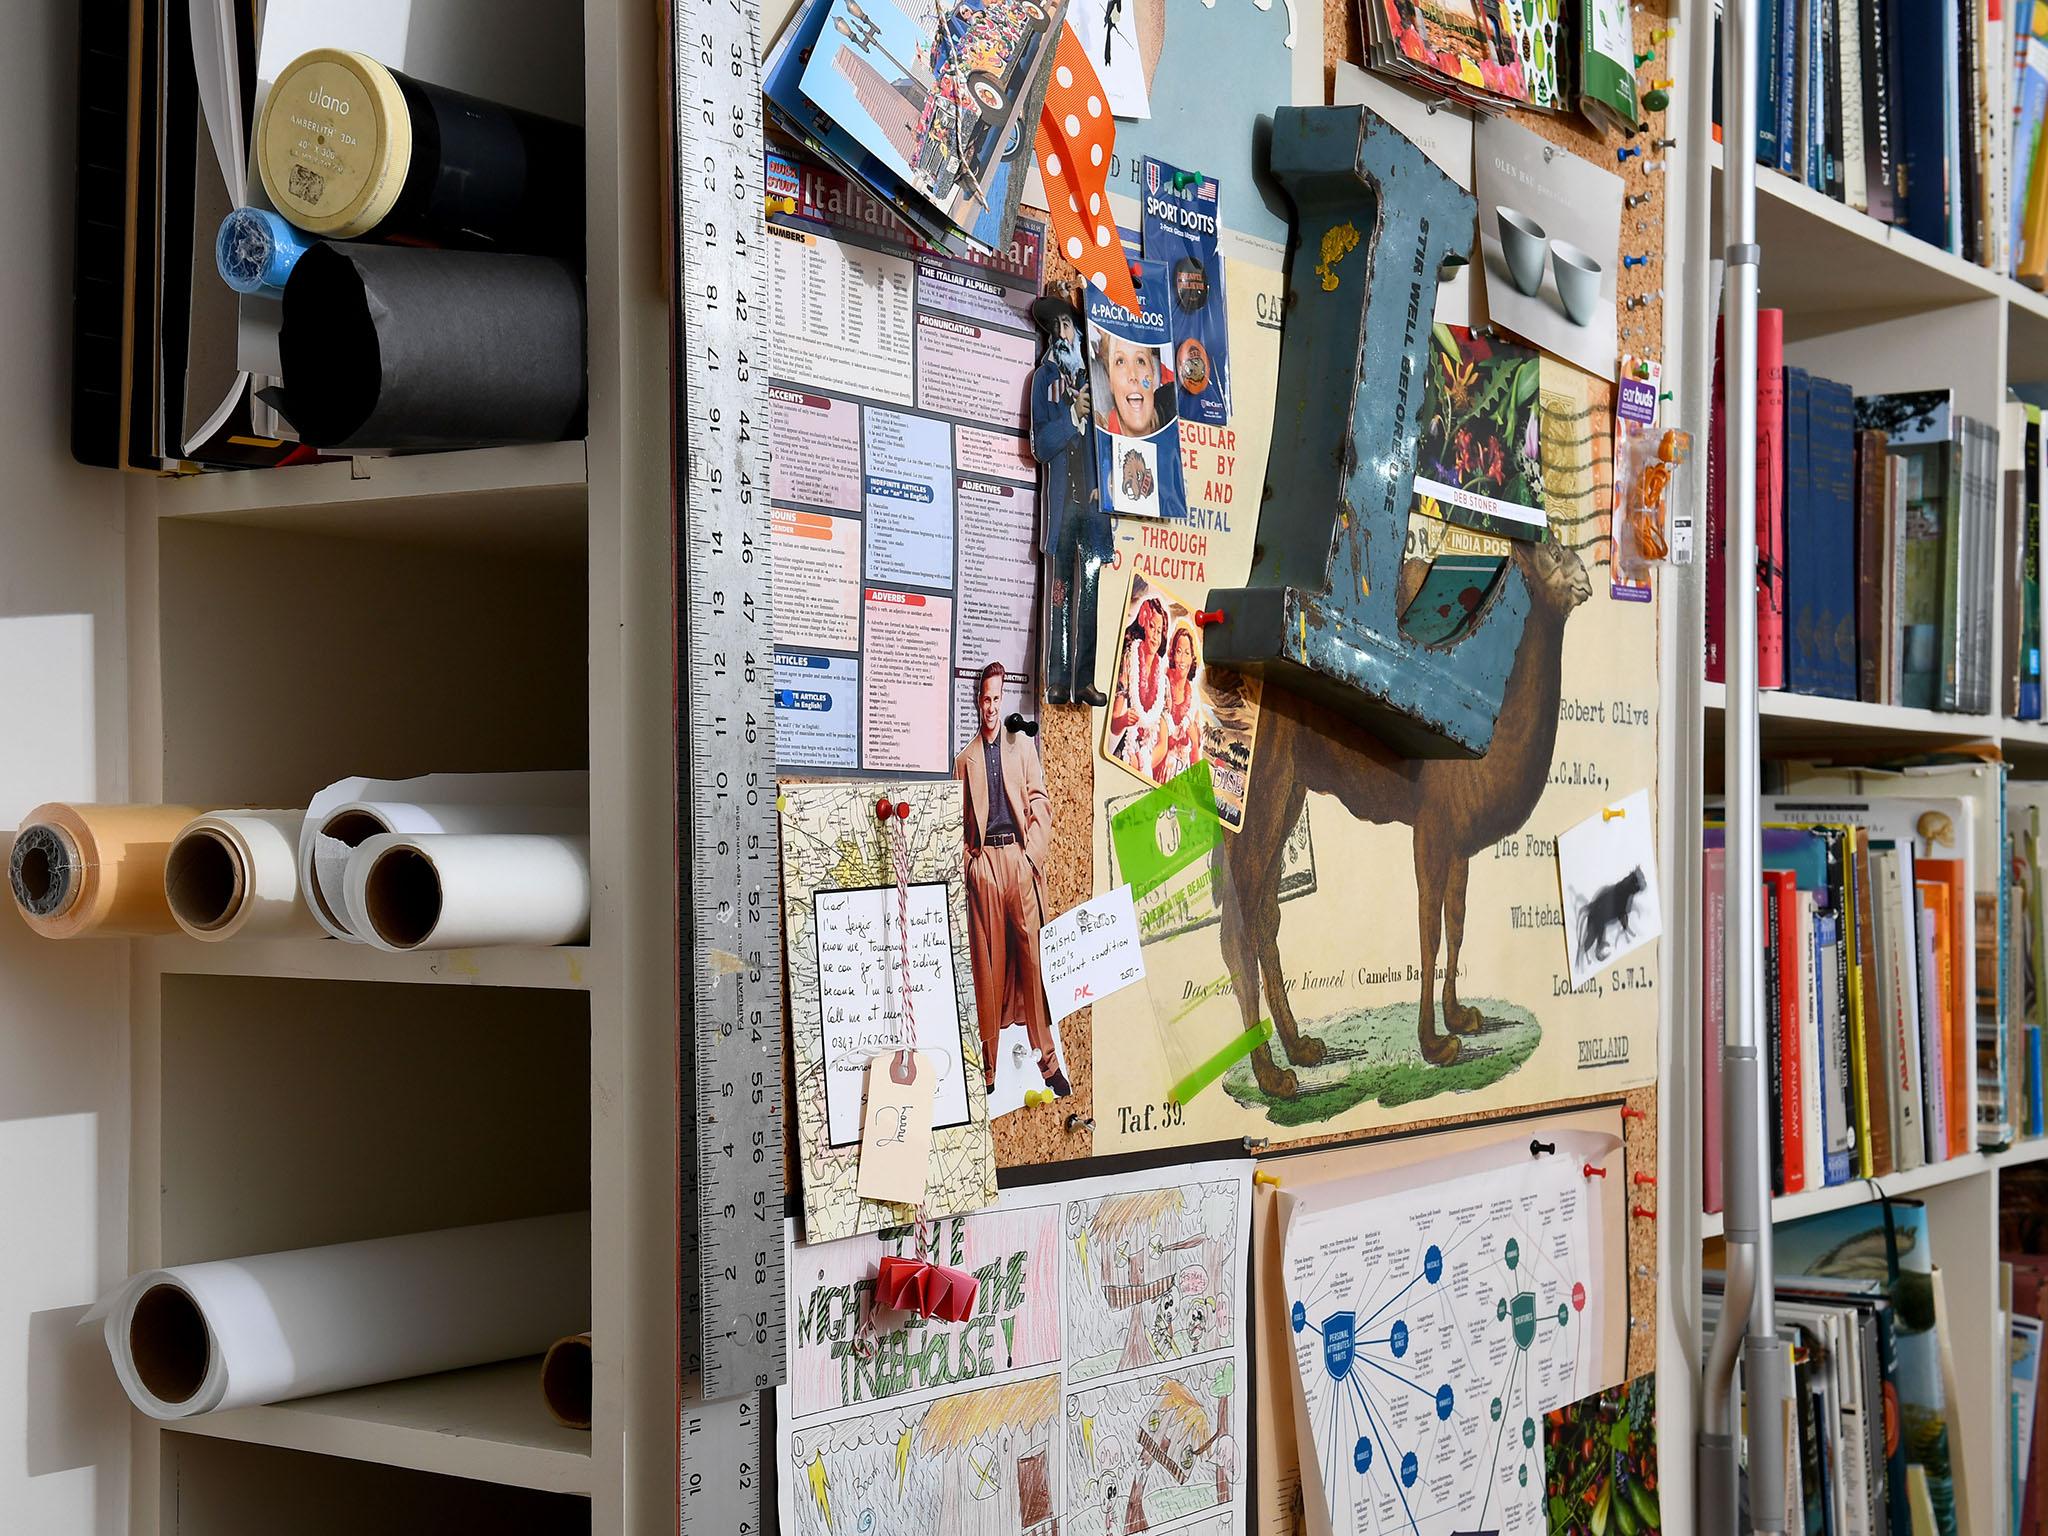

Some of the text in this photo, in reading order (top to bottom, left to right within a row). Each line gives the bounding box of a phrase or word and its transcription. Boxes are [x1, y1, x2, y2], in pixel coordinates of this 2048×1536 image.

[701, 33, 713, 67] 22
[731, 43, 743, 78] 38
[309, 86, 350, 115] ulano
[703, 98, 715, 126] 21
[732, 105, 744, 139] 39
[1876, 72, 1890, 187] SYMBOLS
[704, 156, 716, 192] 20
[733, 165, 746, 200] 40
[1147, 196, 1215, 234] SPORT DOTTS
[705, 222, 717, 248] 19
[735, 230, 747, 257] 41
[767, 225, 806, 243] NUMBERS
[920, 266, 1002, 296] THE ITALIAN ALPHABET
[706, 284, 718, 311] 18
[736, 289, 748, 322] 42
[919, 314, 975, 337] PRONUNCIATION
[1091, 303, 1124, 321] 4-PACK
[707, 347, 720, 371] 17
[737, 349, 749, 382] 43
[1384, 216, 1431, 515] STIR WELL BEFORE USE
[768, 389, 804, 404] ACCENTS
[1622, 385, 1654, 408] earbuds
[709, 408, 721, 433] 16
[738, 410, 750, 443] 44
[1179, 422, 1236, 451] EGULAR
[1217, 455, 1236, 477] BY
[711, 469, 723, 495] 15
[740, 471, 752, 504] 45
[870, 478, 927, 494] INDEFINITE ARTICLES
[961, 480, 1002, 495] ADJECTIVES
[1204, 480, 1233, 504] AND
[1453, 490, 1498, 513] DEB STONER
[771, 511, 797, 522] NOUNS
[712, 531, 724, 556] 14
[741, 532, 753, 564] 46
[1141, 526, 1207, 557] THROUGH
[1451, 532, 1481, 553] INDIA
[1134, 552, 1205, 583] CALCUTTA
[713, 591, 725, 616] 13
[742, 591, 755, 623] 47
[871, 591, 906, 604] ADVERBS
[714, 652, 726, 677] 12
[744, 651, 756, 683] 48
[800, 692, 827, 702] ARTICLES
[1559, 698, 1649, 725] Robert Clive
[715, 716, 727, 737] 11
[745, 712, 757, 743] 49
[716, 772, 728, 799] 10
[746, 772, 758, 806] 50
[1783, 813, 1864, 823] THE VISUAL
[747, 835, 759, 860] 51
[1494, 836, 1519, 859] The
[748, 891, 761, 924] 52
[910, 907, 930, 926] want
[932, 911, 943, 924] to
[1045, 914, 1117, 956] TAISHO PERIOD
[1051, 937, 1129, 984] Excellent condition
[736, 973, 745, 1030] FAIRGATE
[1073, 984, 1095, 1002] PK
[1182, 980, 1209, 1000] Das
[750, 1010, 762, 1044] 54
[1836, 941, 1848, 1089] BIOMEDICAL REVOLUTION
[1577, 1035, 1630, 1063] ENGLAND
[721, 1083, 734, 1098] 5
[751, 1072, 763, 1105] 55
[1790, 1060, 1799, 1138] ANATOMY
[1118, 1104, 1157, 1136] Taf.
[723, 1142, 734, 1158] 4
[752, 1131, 764, 1164] 56
[724, 1203, 736, 1220] 3
[753, 1191, 766, 1222] 57
[725, 1265, 737, 1281] 2
[754, 1252, 767, 1284] 58
[972, 1250, 1029, 1314] THE
[755, 1311, 767, 1344] 59
[689, 1418, 701, 1436] 11
[739, 1403, 750, 1427] 61
[689, 1472, 702, 1496] 10
[739, 1462, 751, 1490] 62
